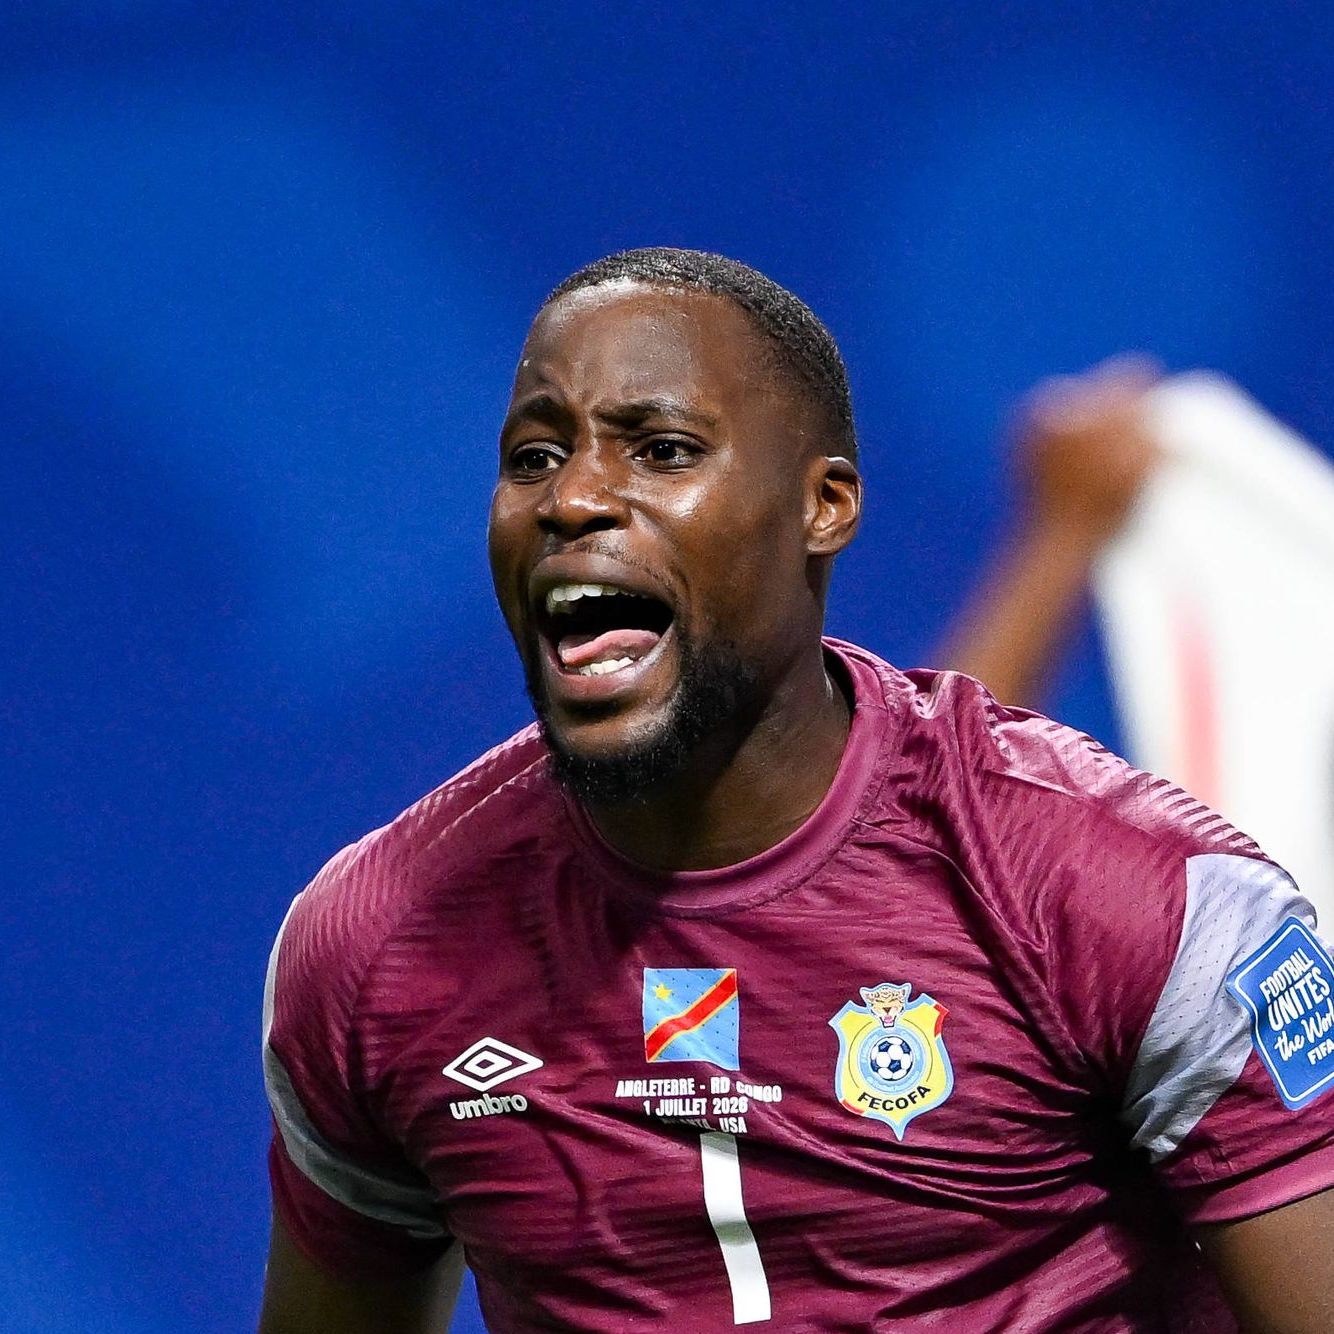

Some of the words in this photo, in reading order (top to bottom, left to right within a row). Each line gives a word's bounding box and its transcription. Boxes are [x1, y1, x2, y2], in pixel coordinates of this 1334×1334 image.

[1259, 947, 1314, 1003] FOOTBALL
[1268, 967, 1331, 1031] UNITES
[1274, 1031, 1304, 1061] the
[615, 1078, 696, 1097] ANGLETERRE
[711, 1076, 731, 1094] RD
[736, 1081, 783, 1103] CONGO
[857, 1085, 931, 1111] FECOFA
[449, 1093, 528, 1120] umbro
[643, 1100, 651, 1116] 1
[655, 1098, 707, 1116] JUILLET
[713, 1097, 748, 1115] 2026
[719, 1117, 748, 1134] USA
[700, 1132, 771, 1325] 1
